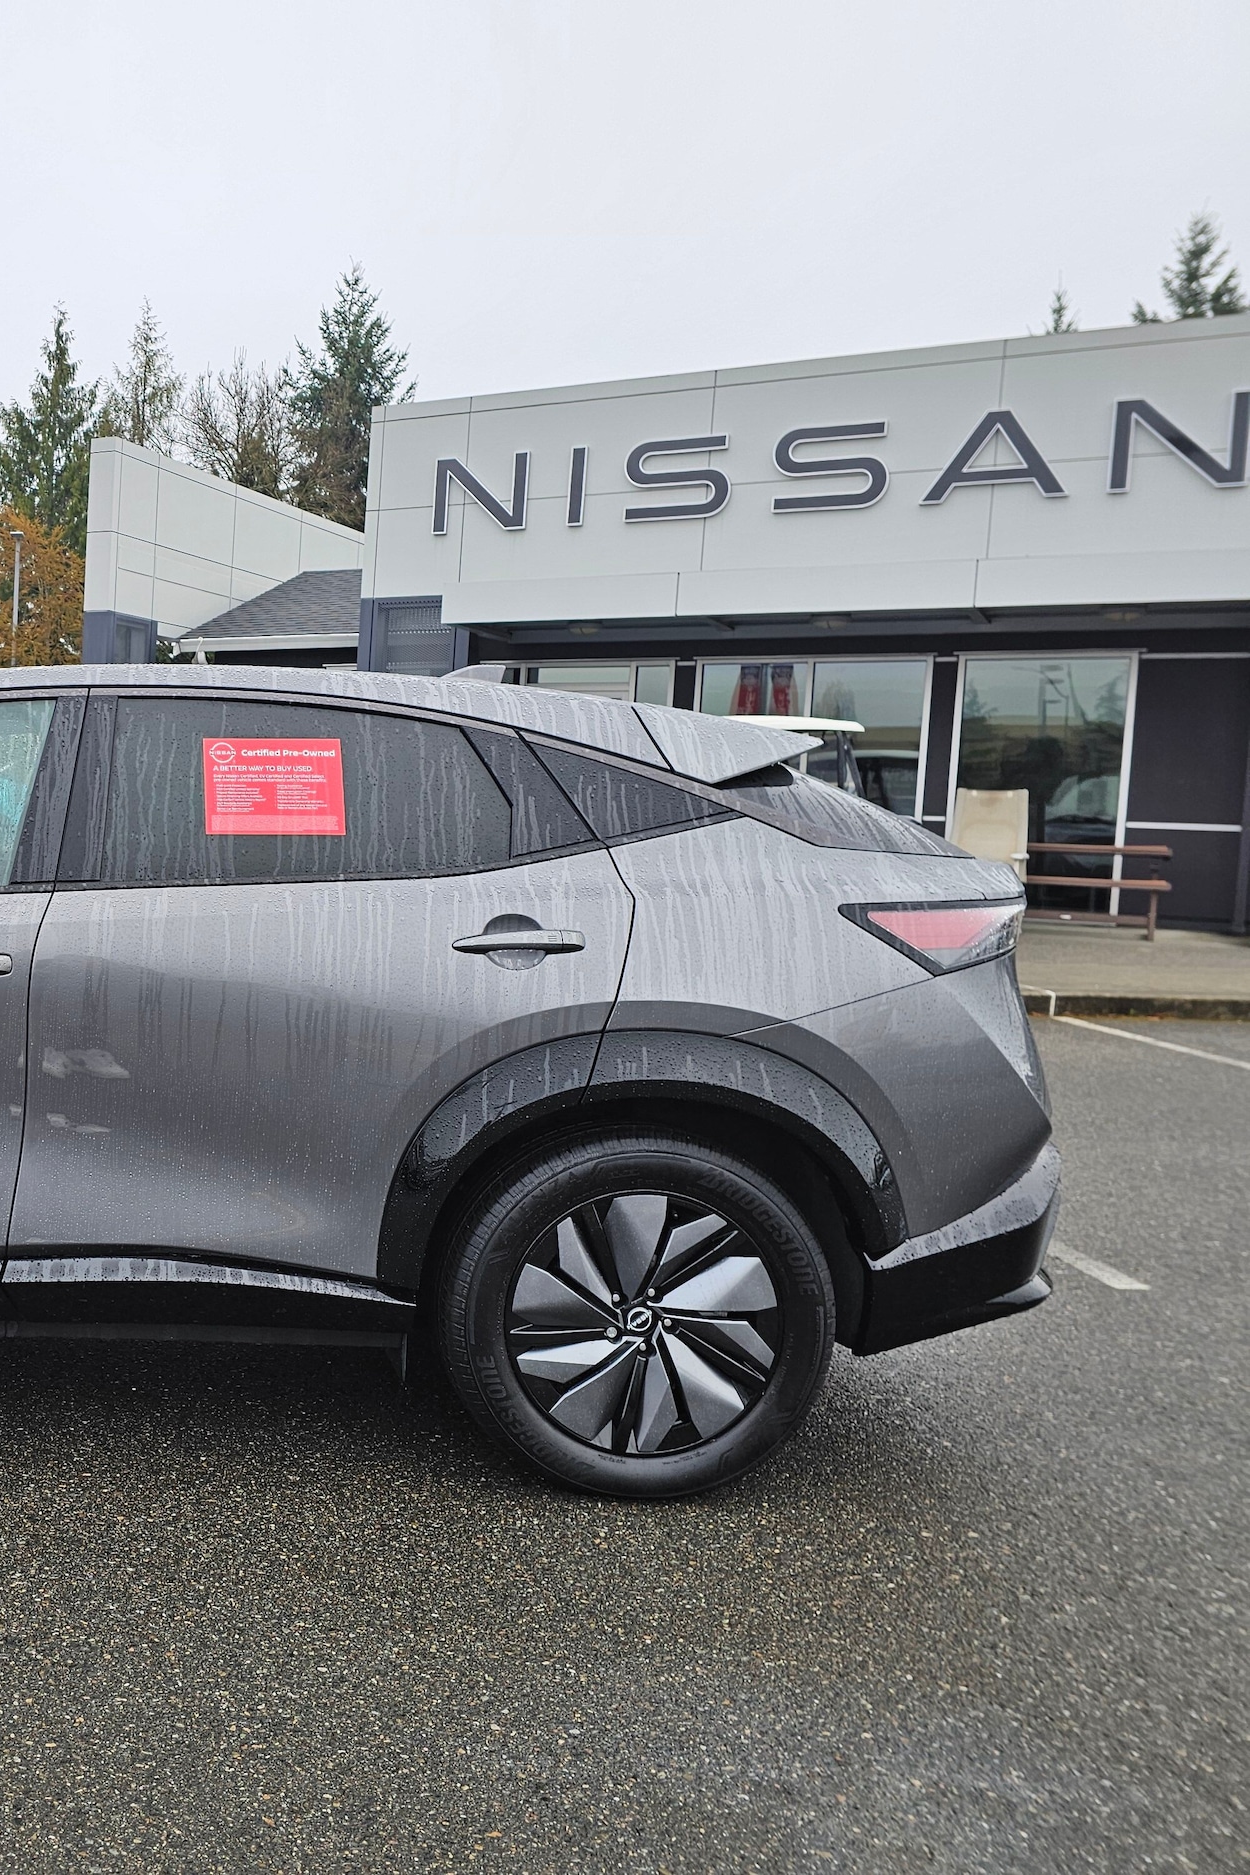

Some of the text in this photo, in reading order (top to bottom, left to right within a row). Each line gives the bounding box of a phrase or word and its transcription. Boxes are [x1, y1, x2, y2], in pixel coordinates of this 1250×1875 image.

[431, 388, 1250, 536] NISSAN
[241, 749, 336, 757] Certified Pre-Owned
[696, 1169, 819, 1296] BRIDGESTONE
